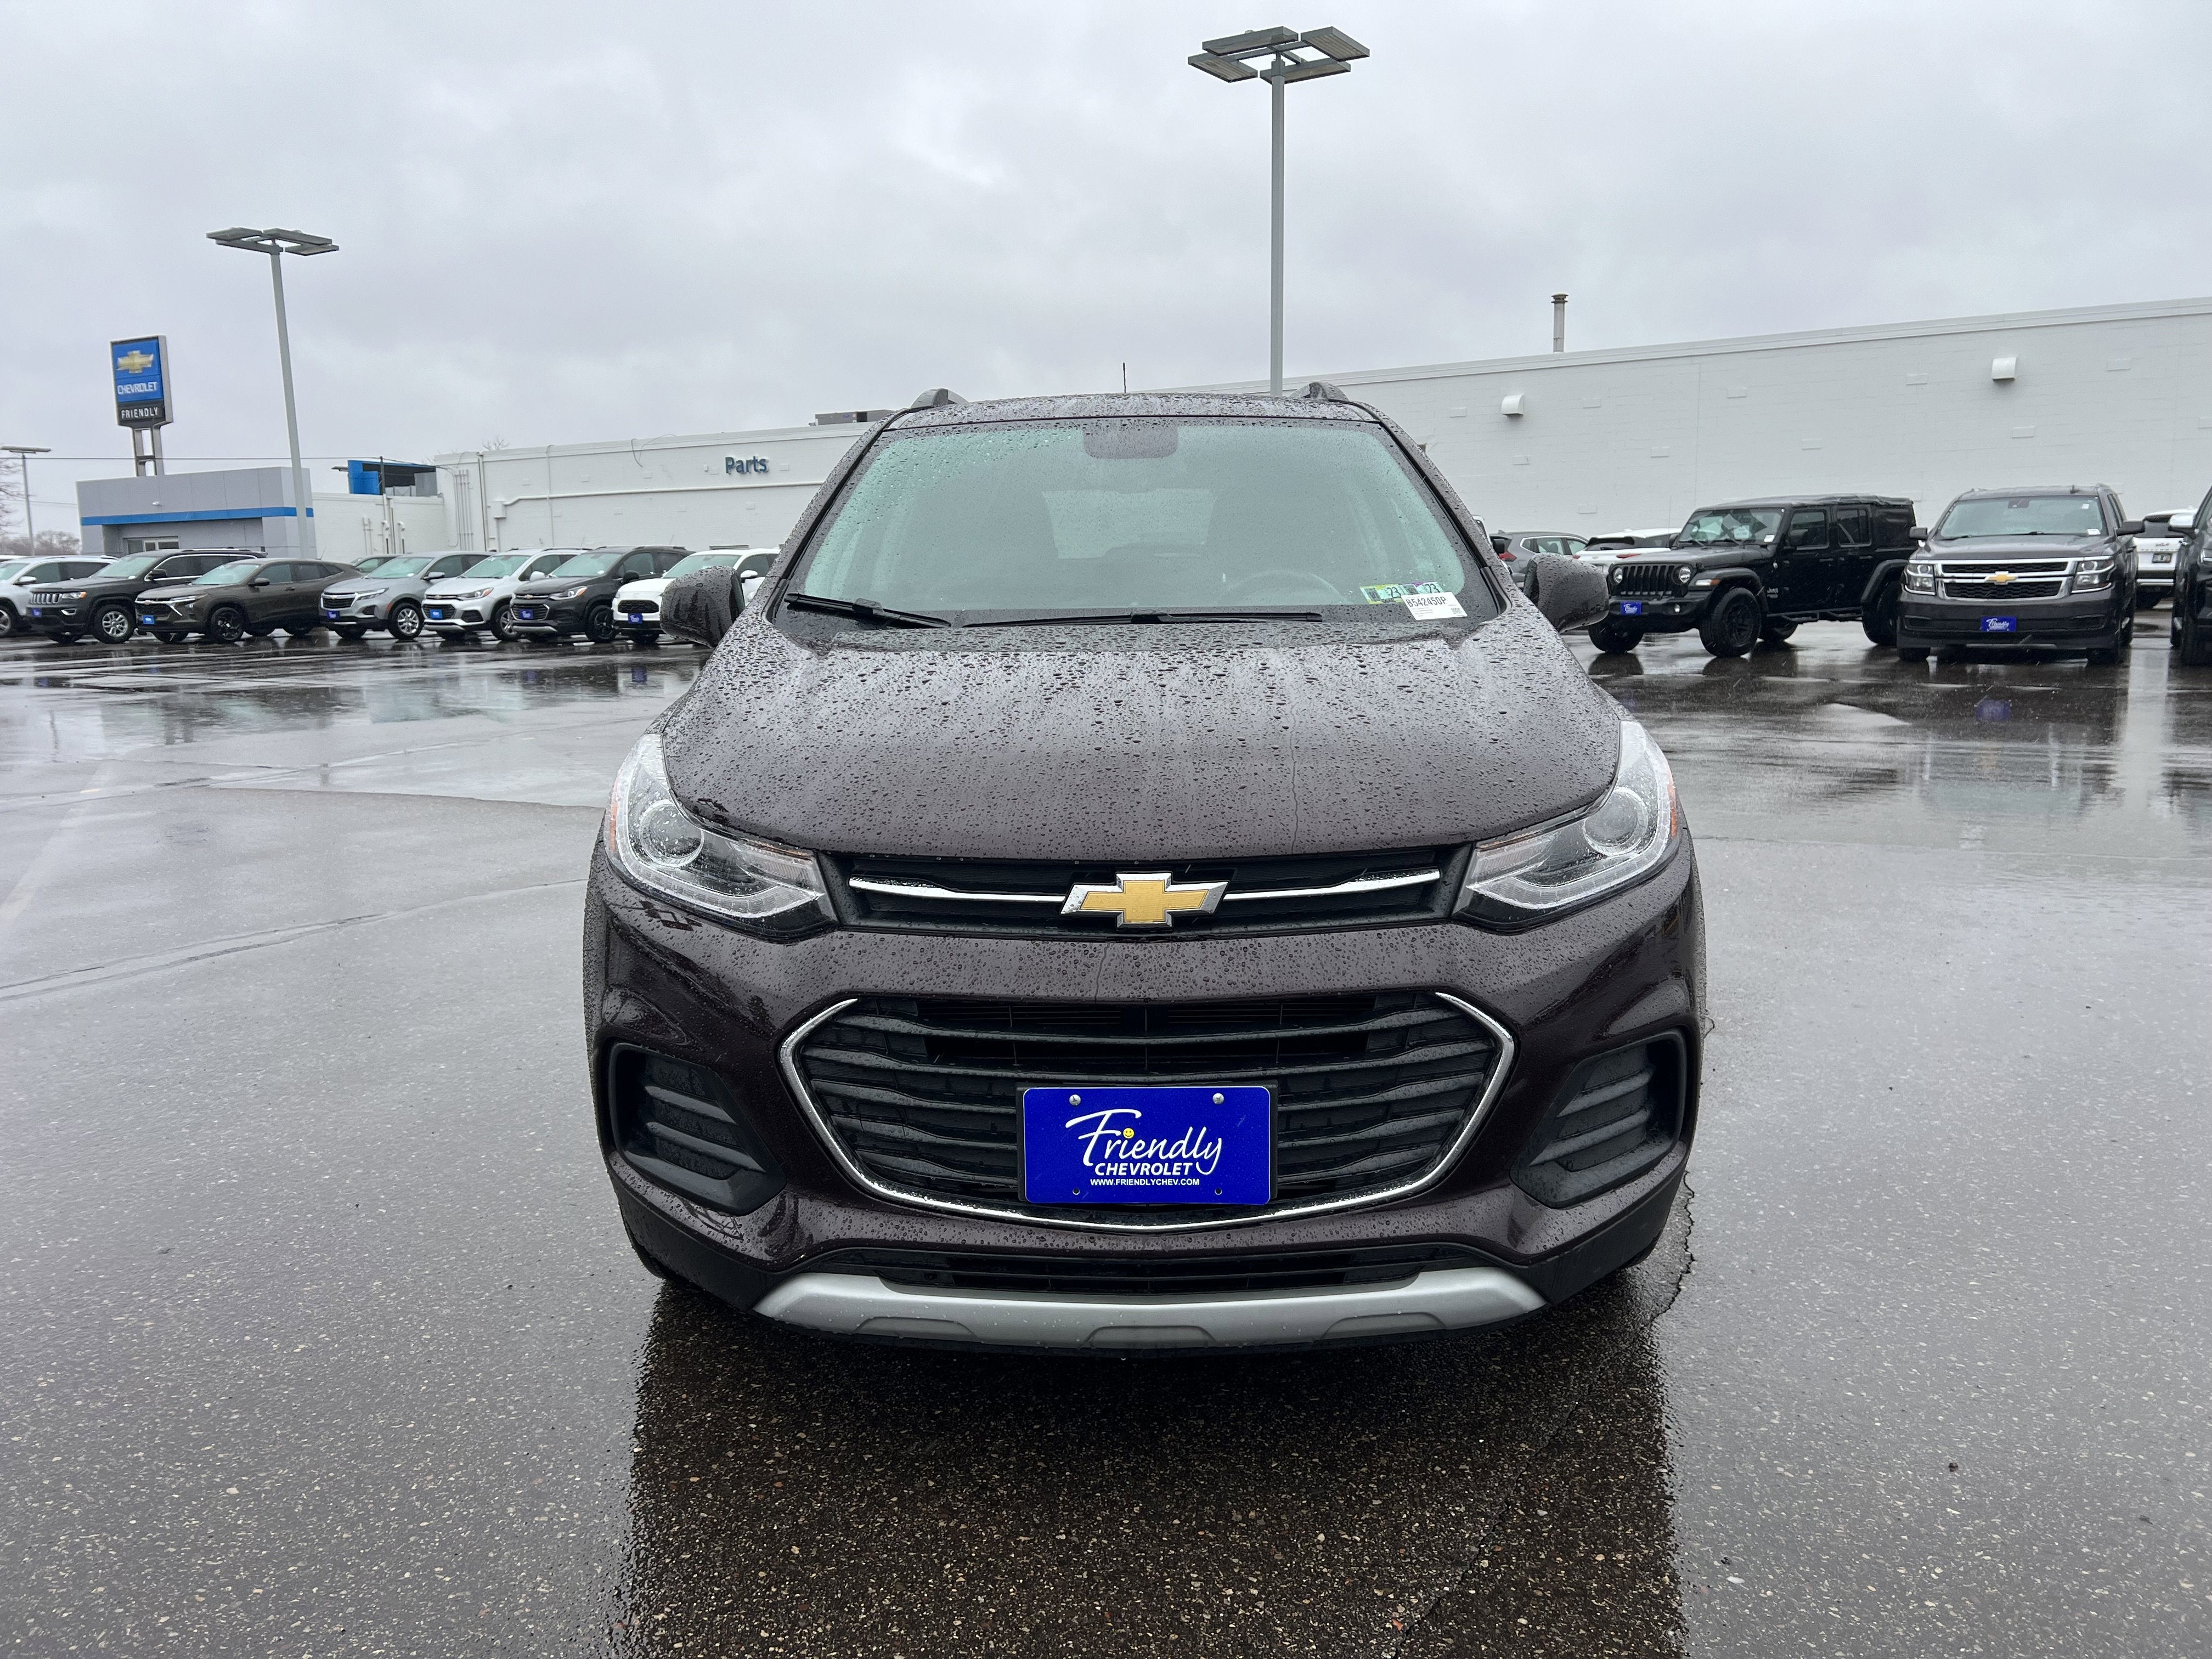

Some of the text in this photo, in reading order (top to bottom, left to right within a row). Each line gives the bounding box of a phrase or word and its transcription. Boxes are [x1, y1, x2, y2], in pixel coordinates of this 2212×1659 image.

[117, 381, 157, 394] CHEVROLET
[121, 407, 158, 419] FRIENDLY
[725, 456, 769, 475] Parts
[1406, 596, 1446, 607] B542450P
[1065, 1109, 1222, 1175] Friendly
[1094, 1163, 1193, 1176] CHEVROLET
